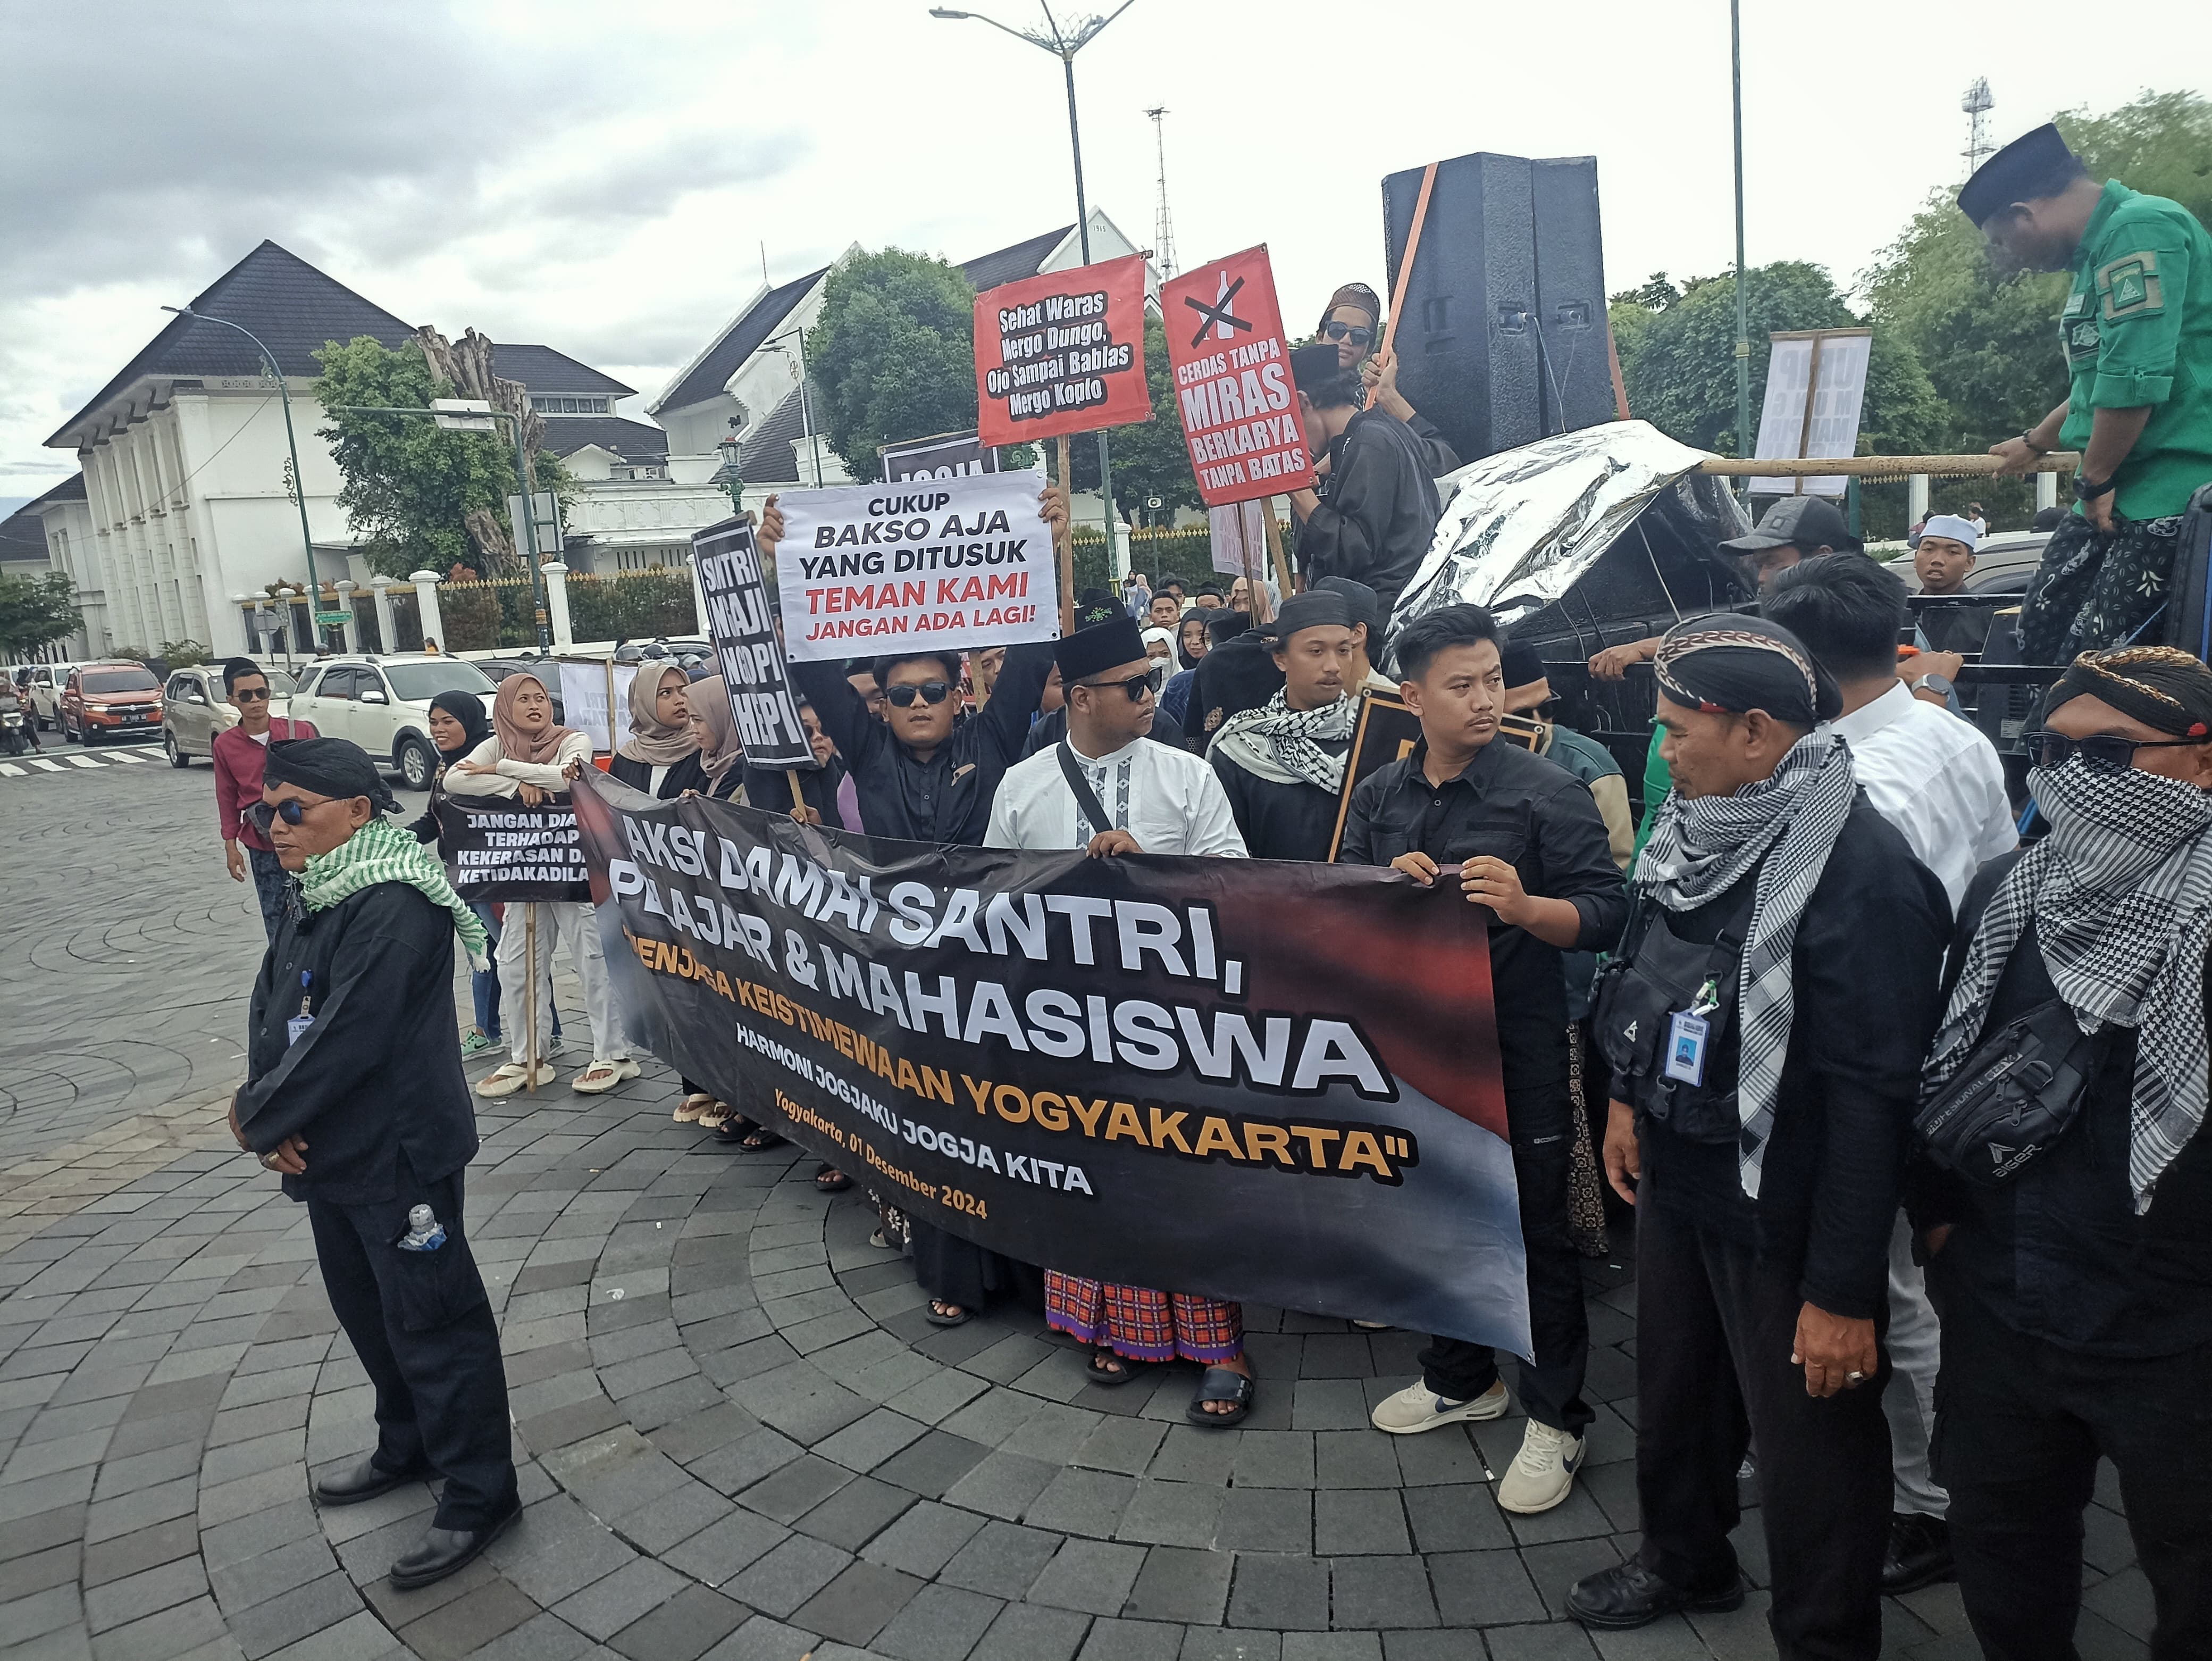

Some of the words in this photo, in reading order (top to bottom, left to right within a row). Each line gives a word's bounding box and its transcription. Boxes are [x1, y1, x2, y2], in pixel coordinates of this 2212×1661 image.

[999, 303, 1042, 333] Sehat
[1045, 293, 1104, 322] Waras
[1001, 333, 1042, 362] Mergo
[1047, 321, 1107, 350] Dungo,
[1177, 353, 1227, 385] CERDAS
[1229, 337, 1281, 369] TANPA
[987, 370, 1010, 394] Ojo
[1012, 354, 1064, 387] Sampai
[1069, 345, 1128, 374] Bablas
[1010, 389, 1051, 416] Mergo
[1054, 377, 1102, 406] Koplo
[1180, 362, 1291, 433] MIRAS
[1191, 413, 1300, 464] BERKARYA
[1200, 462, 1246, 490] TANPA
[1247, 448, 1305, 481] BATAS
[868, 493, 950, 516] CUKUP
[815, 518, 930, 548] BAKSO
[940, 510, 1010, 538] AJA
[800, 552, 884, 580] YANG
[894, 539, 1027, 573] DITUSUK
[806, 585, 925, 614] TEMAN
[936, 571, 1028, 603] KAMI
[806, 616, 905, 641] JANGAN
[914, 611, 964, 632] ADA
[974, 605, 1036, 628] LAGI!
[466, 813, 542, 829] JANGAN
[484, 829, 580, 847] TERHADAP
[457, 848, 563, 865] KEKERASAN
[622, 815, 713, 881] AKSI
[717, 836, 879, 934] DAMAI
[889, 881, 1242, 994] SANTRI,
[784, 928, 819, 992] &
[819, 942, 1390, 1094] MAHASISWA
[736, 977, 955, 1105] KEISTIMEWAAN
[960, 1073, 1409, 1177] YOGYAKARTA"
[736, 1022, 814, 1081] HARMONI
[815, 1064, 899, 1136] JOGJAKU
[902, 1119, 1001, 1174] JOGJA
[1004, 1151, 1094, 1196] KITA
[774, 1088, 846, 1149] Yogyakarta,
[850, 1132, 864, 1156] 01
[866, 1143, 937, 1199] Desember
[942, 1184, 987, 1220] 2024
